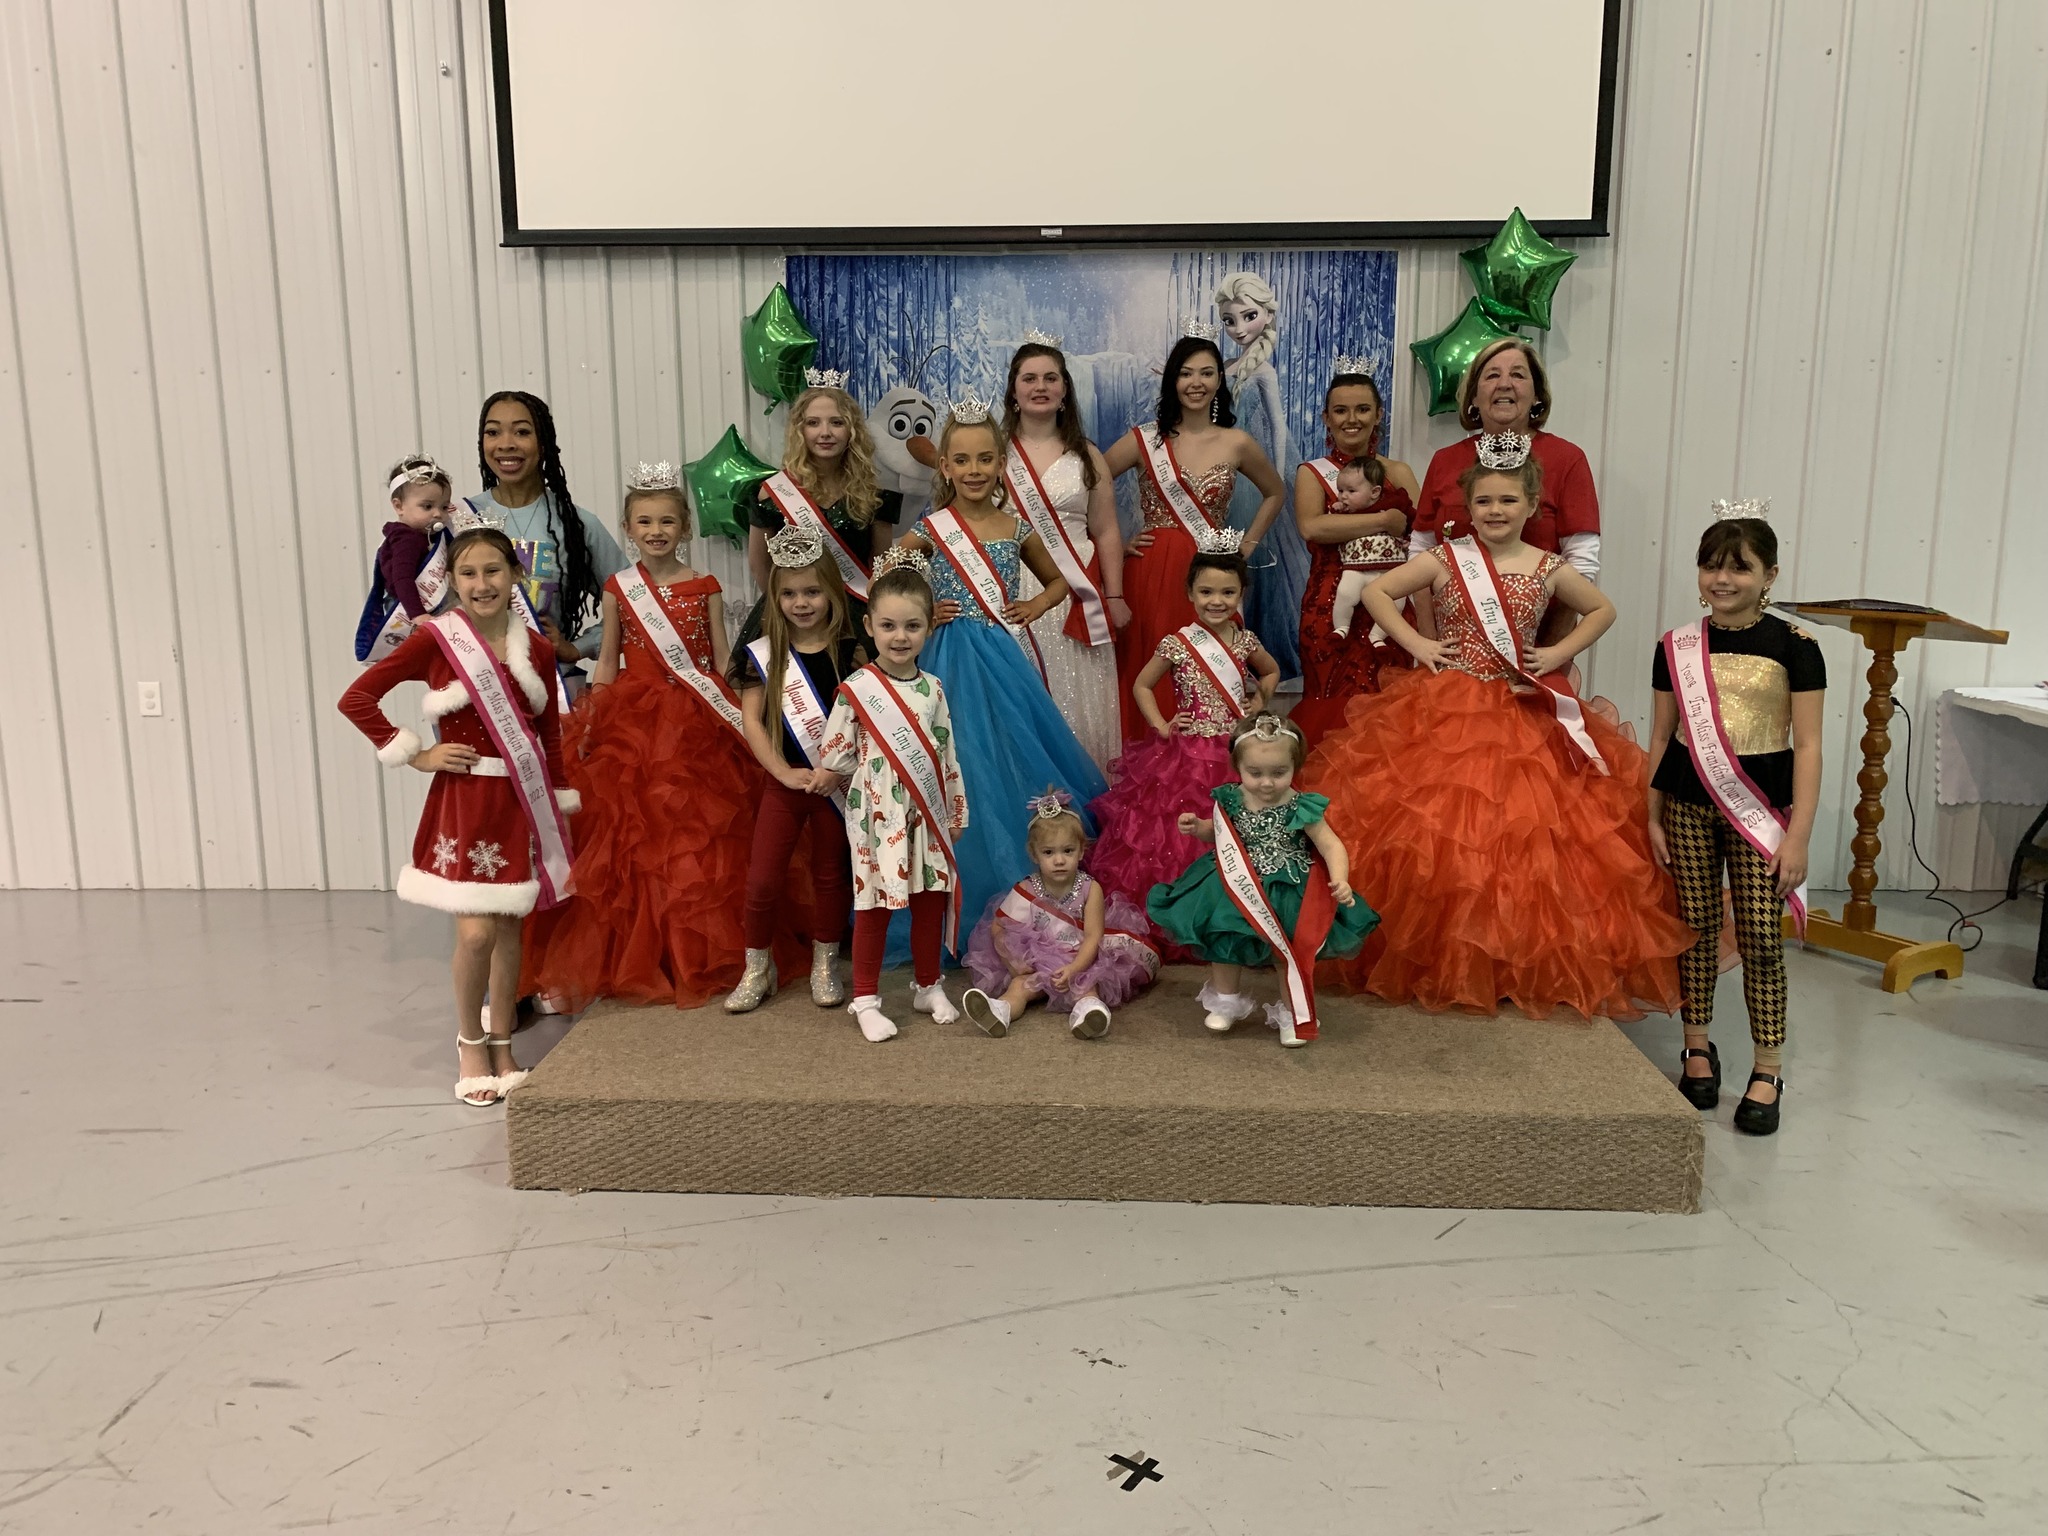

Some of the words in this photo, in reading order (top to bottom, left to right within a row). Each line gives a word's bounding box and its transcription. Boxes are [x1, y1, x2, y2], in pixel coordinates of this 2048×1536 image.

[795, 506, 814, 529] Tiny
[1010, 465, 1028, 489] Tiny
[1022, 485, 1041, 512] Miss
[1034, 511, 1060, 550] Holiday
[1157, 459, 1170, 484] Tiny
[1166, 482, 1185, 507] Miss
[1181, 505, 1208, 534] Holida
[980, 577, 1001, 604] Tiny
[1460, 558, 1480, 581] Tiny
[1480, 597, 1498, 625] Tiny
[1491, 628, 1510, 657] Miss
[642, 611, 666, 632] Petite
[664, 643, 690, 671] Tiny
[684, 671, 710, 692] Miss
[708, 692, 743, 729] Holiday
[1680, 663, 1697, 689] Young
[449, 632, 476, 655] Senior
[476, 668, 496, 693] Tiny
[487, 690, 507, 715] Miss
[498, 714, 526, 753] Franklin
[516, 752, 536, 784] County
[784, 679, 808, 716] Young
[801, 716, 823, 741] Miss
[1688, 695, 1708, 718] Tiny
[1695, 718, 1713, 743] Miss
[866, 694, 889, 714] Mini
[892, 726, 912, 752] Tiny
[906, 749, 926, 775] Miss
[920, 772, 938, 809] Holiday
[1701, 742, 1729, 782] Franklin
[1718, 781, 1748, 811] County
[1742, 807, 1767, 829] 2023
[1221, 843, 1238, 874] Tiny
[1234, 874, 1260, 906] Miss
